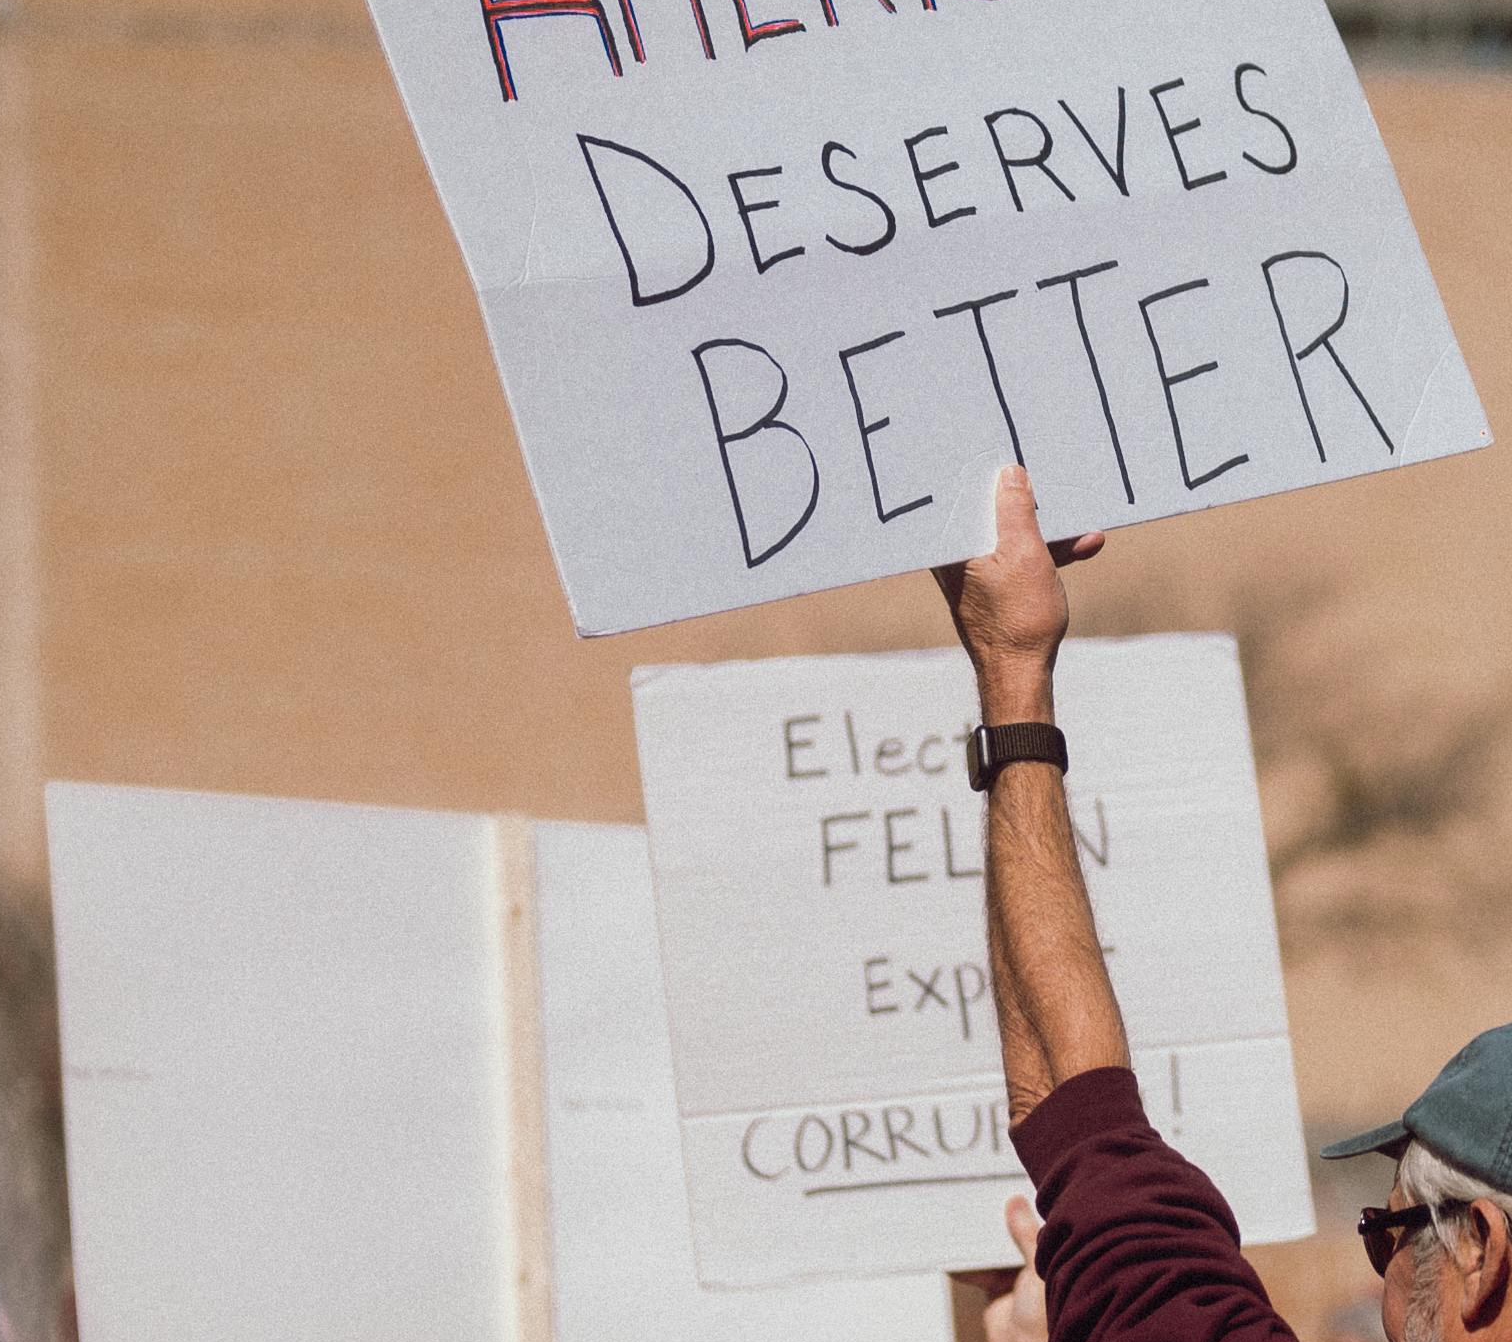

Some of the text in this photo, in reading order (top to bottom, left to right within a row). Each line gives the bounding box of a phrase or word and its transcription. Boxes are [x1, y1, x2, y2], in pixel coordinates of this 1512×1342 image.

[576, 62, 1298, 306] DESERVES
[691, 250, 1395, 568] BETTER
[820, 795, 1112, 889] FELN
